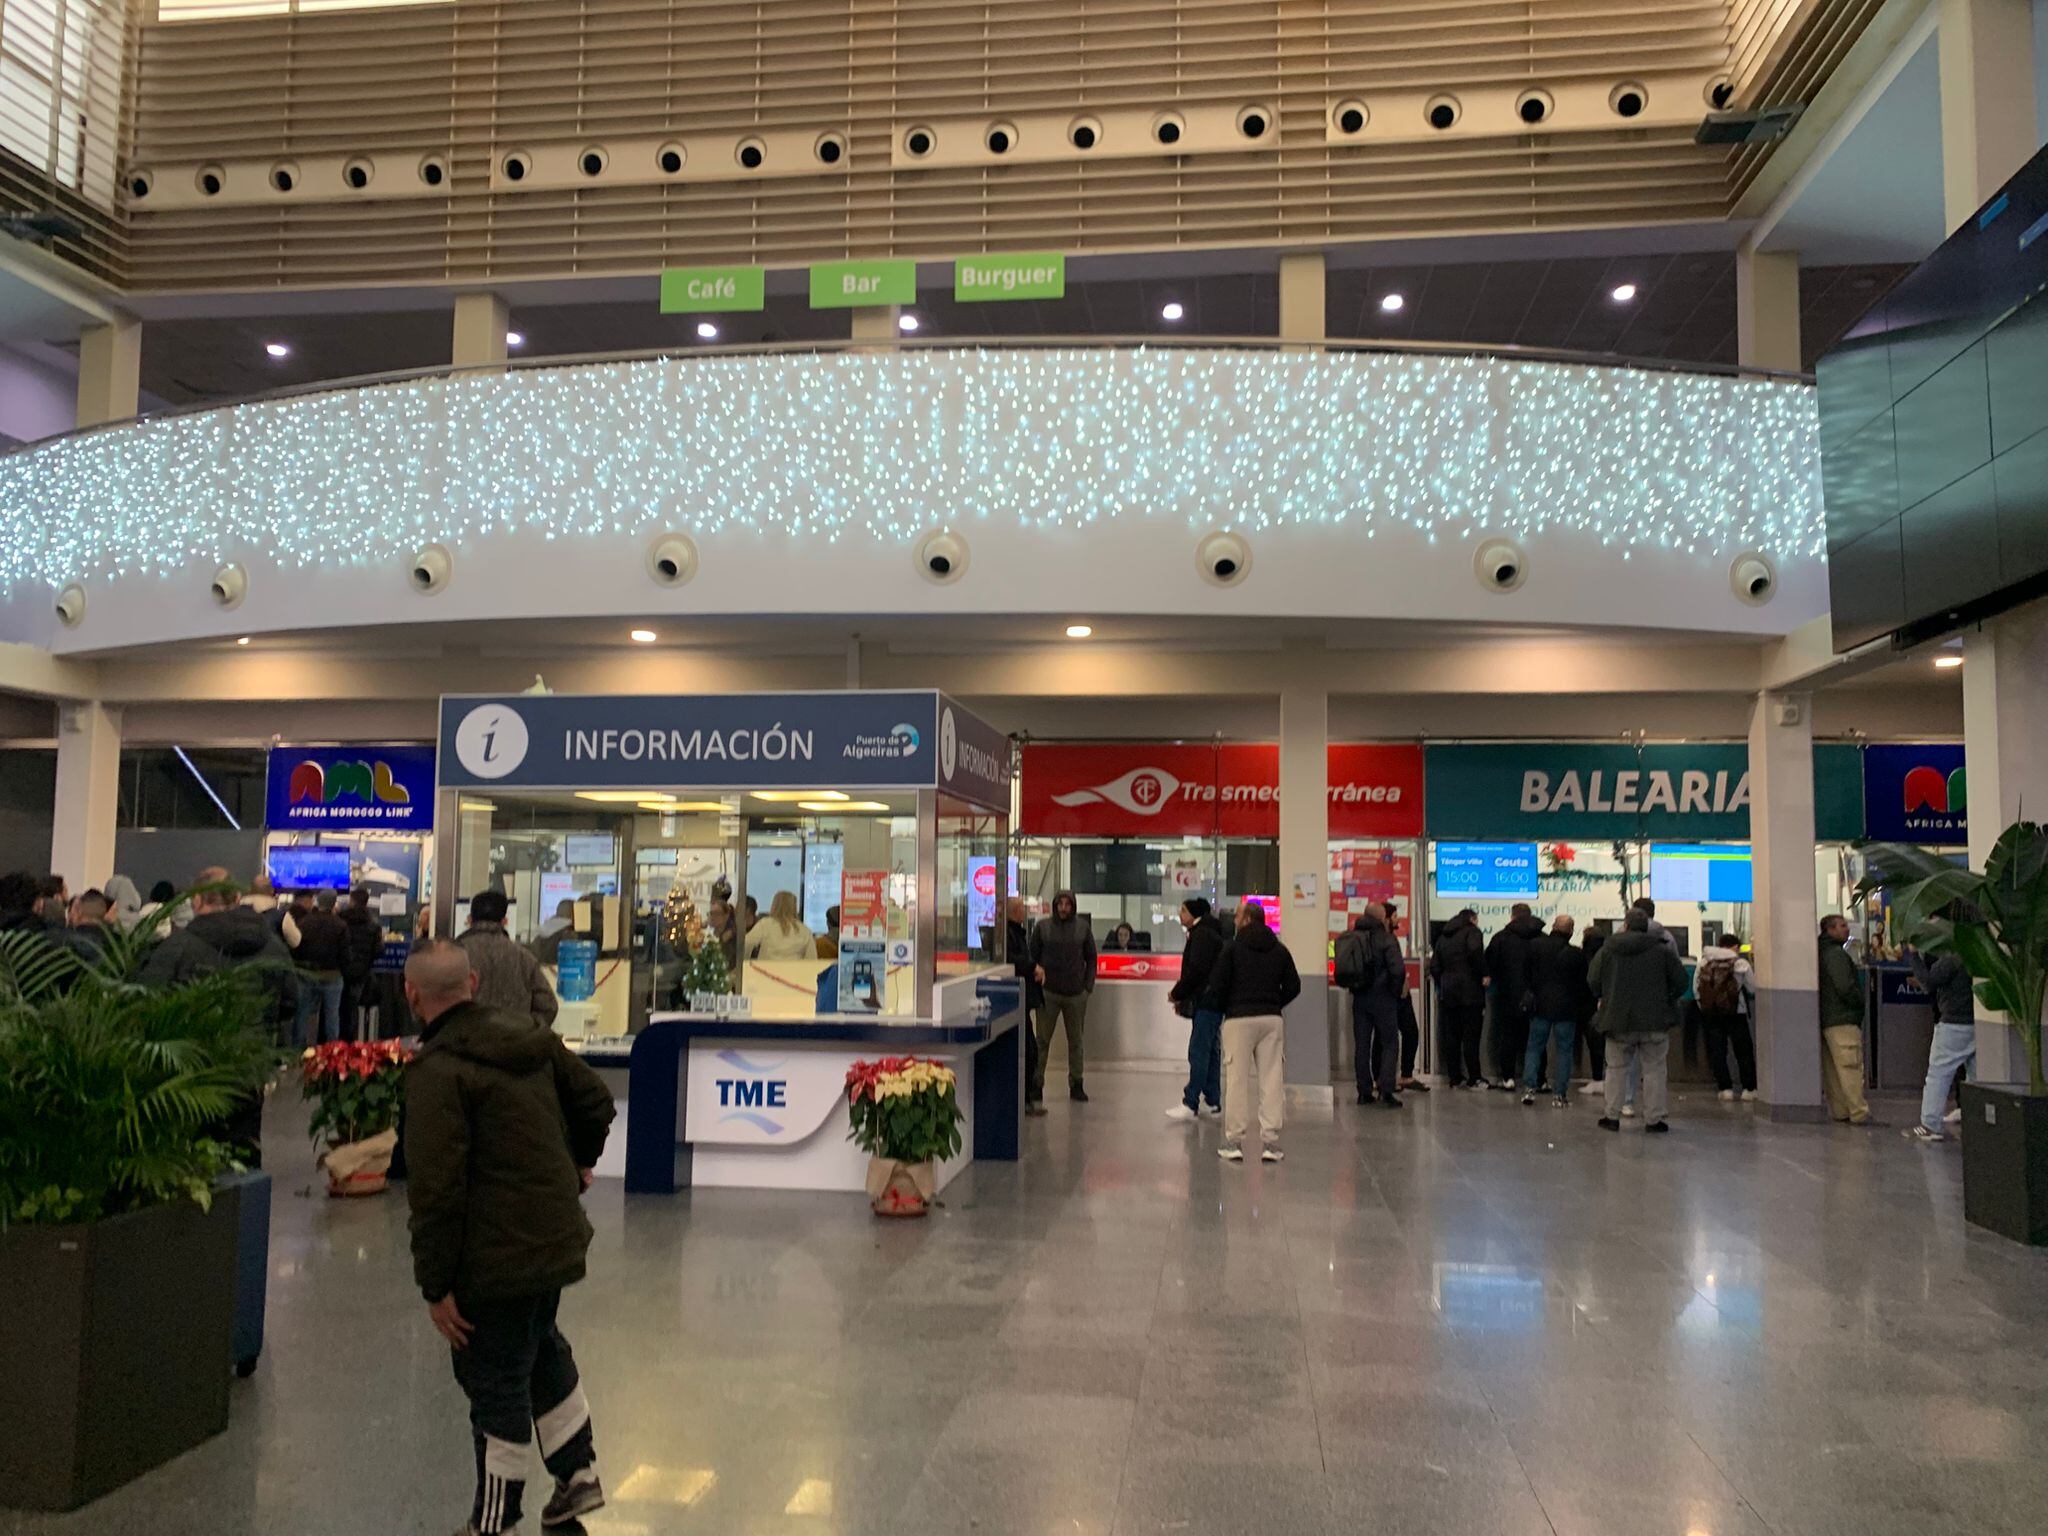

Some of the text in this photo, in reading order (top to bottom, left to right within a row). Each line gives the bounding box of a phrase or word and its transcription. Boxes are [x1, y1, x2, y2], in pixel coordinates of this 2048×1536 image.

[687, 277, 736, 299] Café
[842, 274, 880, 295] Bar
[962, 267, 1057, 291] Burguer
[564, 721, 813, 761] INFORMACIÓN
[856, 734, 899, 744] Puerto de
[843, 744, 900, 760] Algeciras
[958, 740, 999, 785] INFORMACIÓN
[288, 807, 327, 817] AFRICA
[330, 807, 383, 817] MOROCCO
[1905, 819, 1953, 830] AFRICA
[1494, 857, 1529, 868] Ceuta
[715, 1080, 787, 1107] TME
